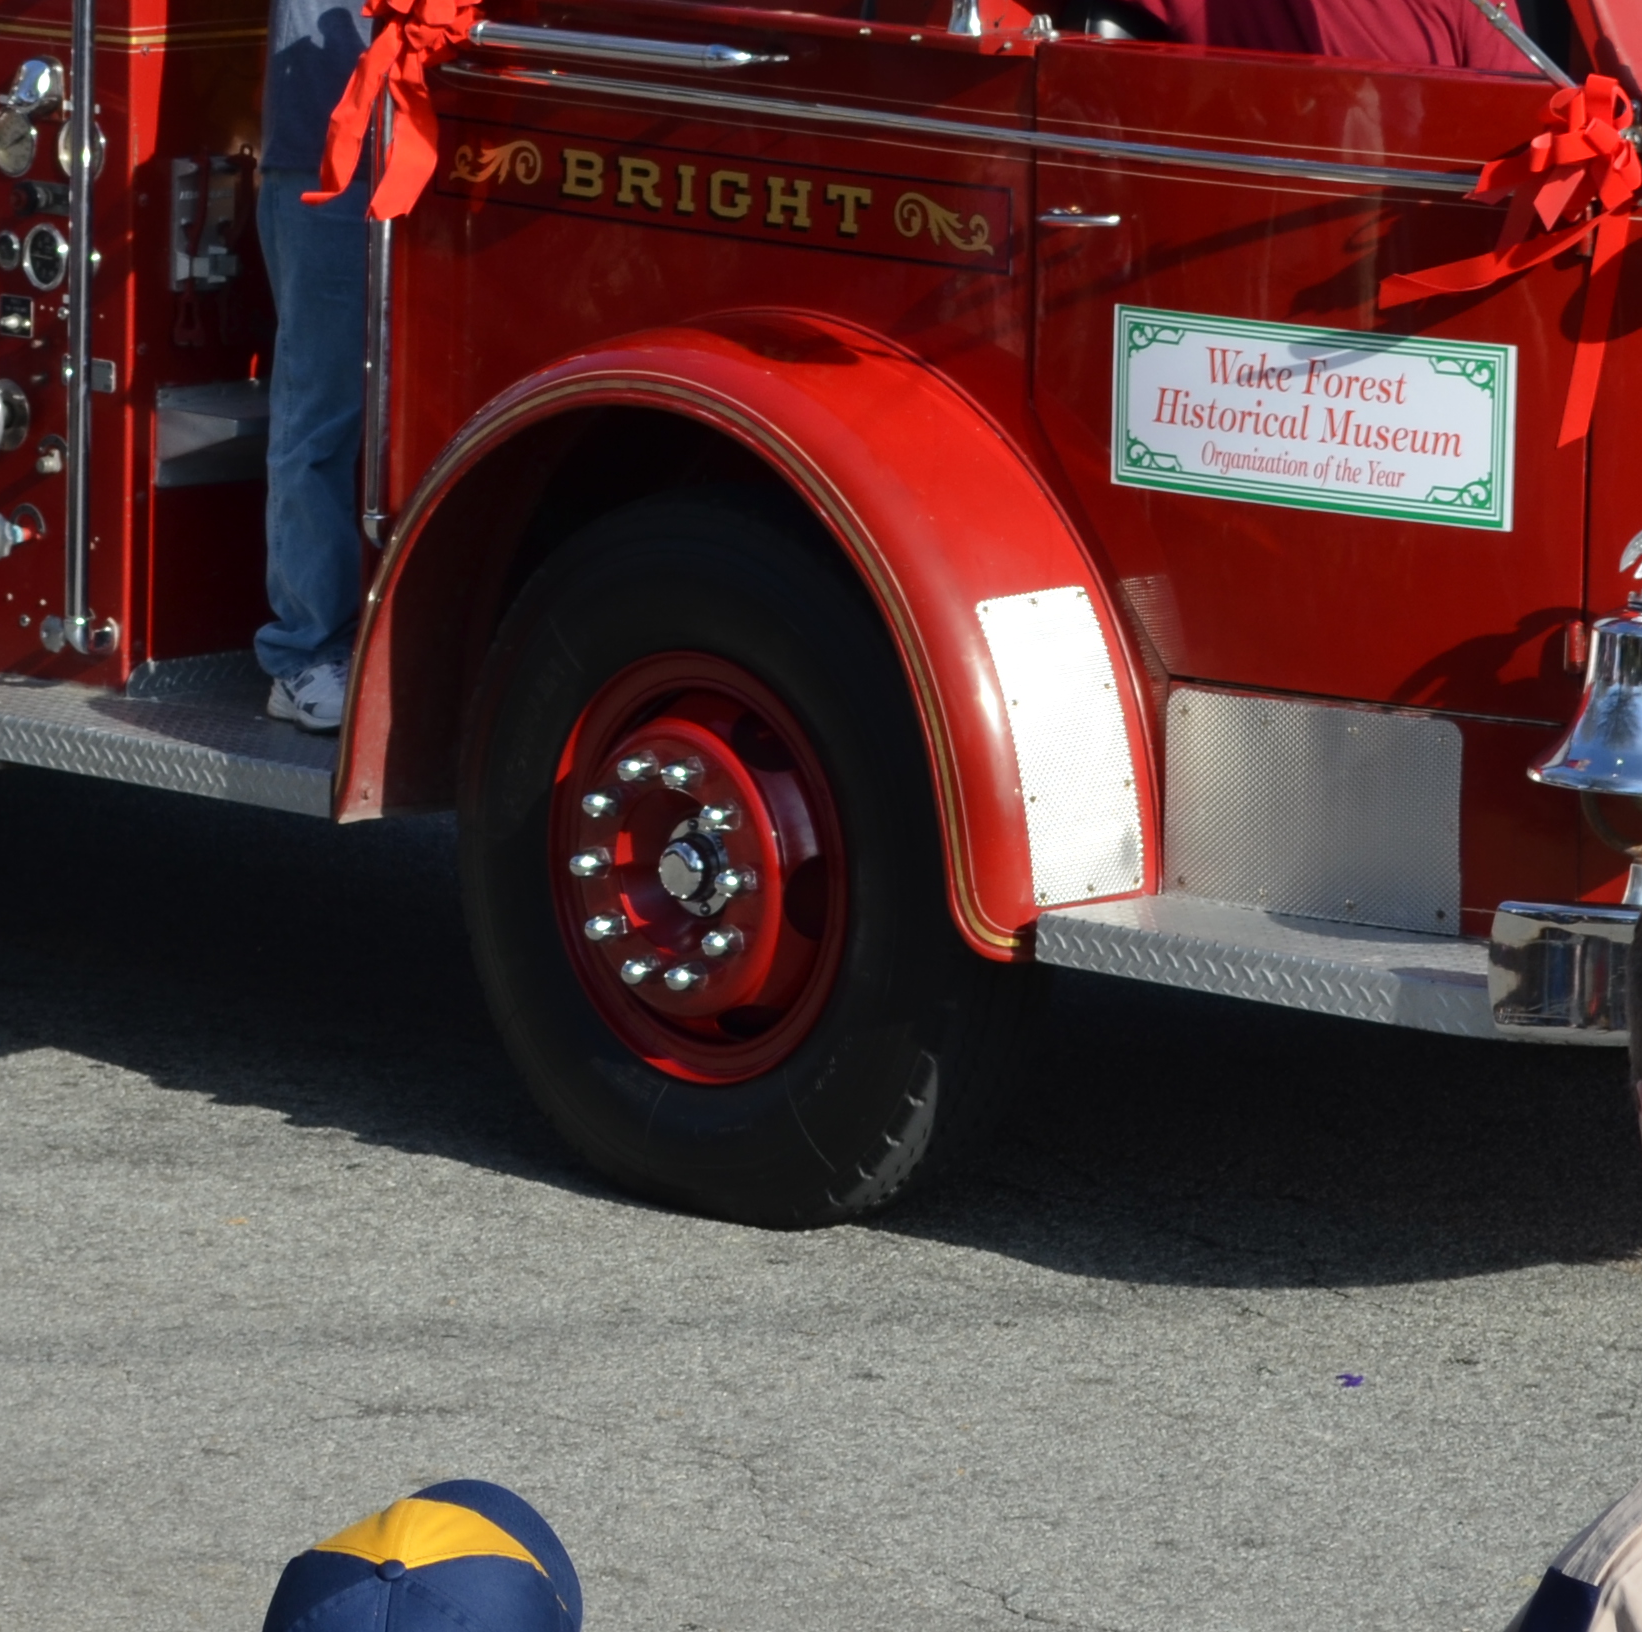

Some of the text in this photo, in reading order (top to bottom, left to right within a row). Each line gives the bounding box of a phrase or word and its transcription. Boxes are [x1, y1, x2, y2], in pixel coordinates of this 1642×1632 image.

[560, 148, 873, 235] BRIGHT
[1205, 346, 1407, 405] Wake Forest
[1154, 386, 1463, 458] Historical Museum
[1200, 440, 1406, 489] Organization of the Year
